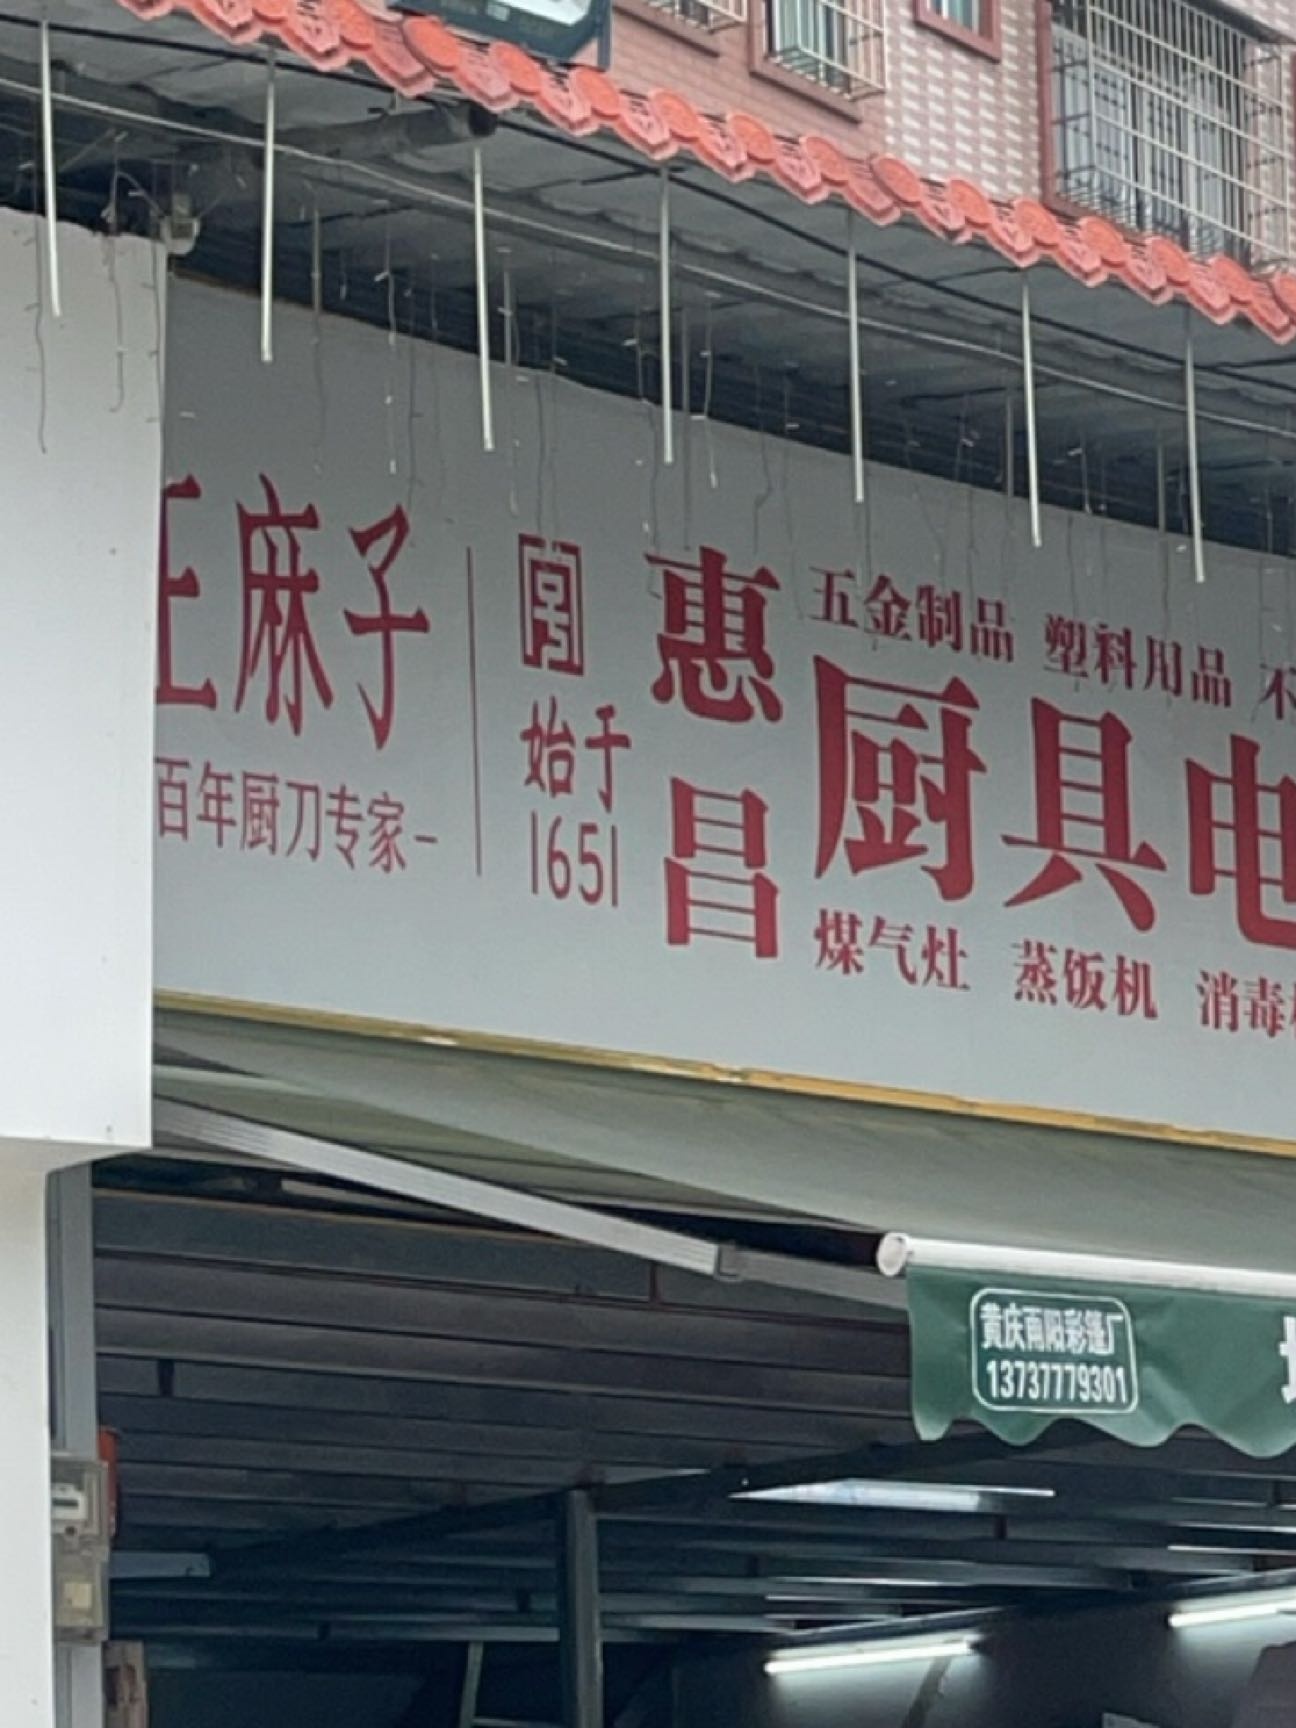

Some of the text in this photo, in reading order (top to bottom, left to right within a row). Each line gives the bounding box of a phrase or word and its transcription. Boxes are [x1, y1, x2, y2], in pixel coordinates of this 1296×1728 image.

[809, 565, 1014, 663] 五金制品
[1043, 611, 1233, 708] 塑料用品
[520, 697, 631, 813] 始于
[644, 545, 784, 959] 惠昌
[530, 810, 618, 908] 1651
[814, 909, 970, 992] 煤气灶
[1012, 938, 1159, 1020] 蒸饭机
[986, 1360, 1127, 1404] 13737779301
